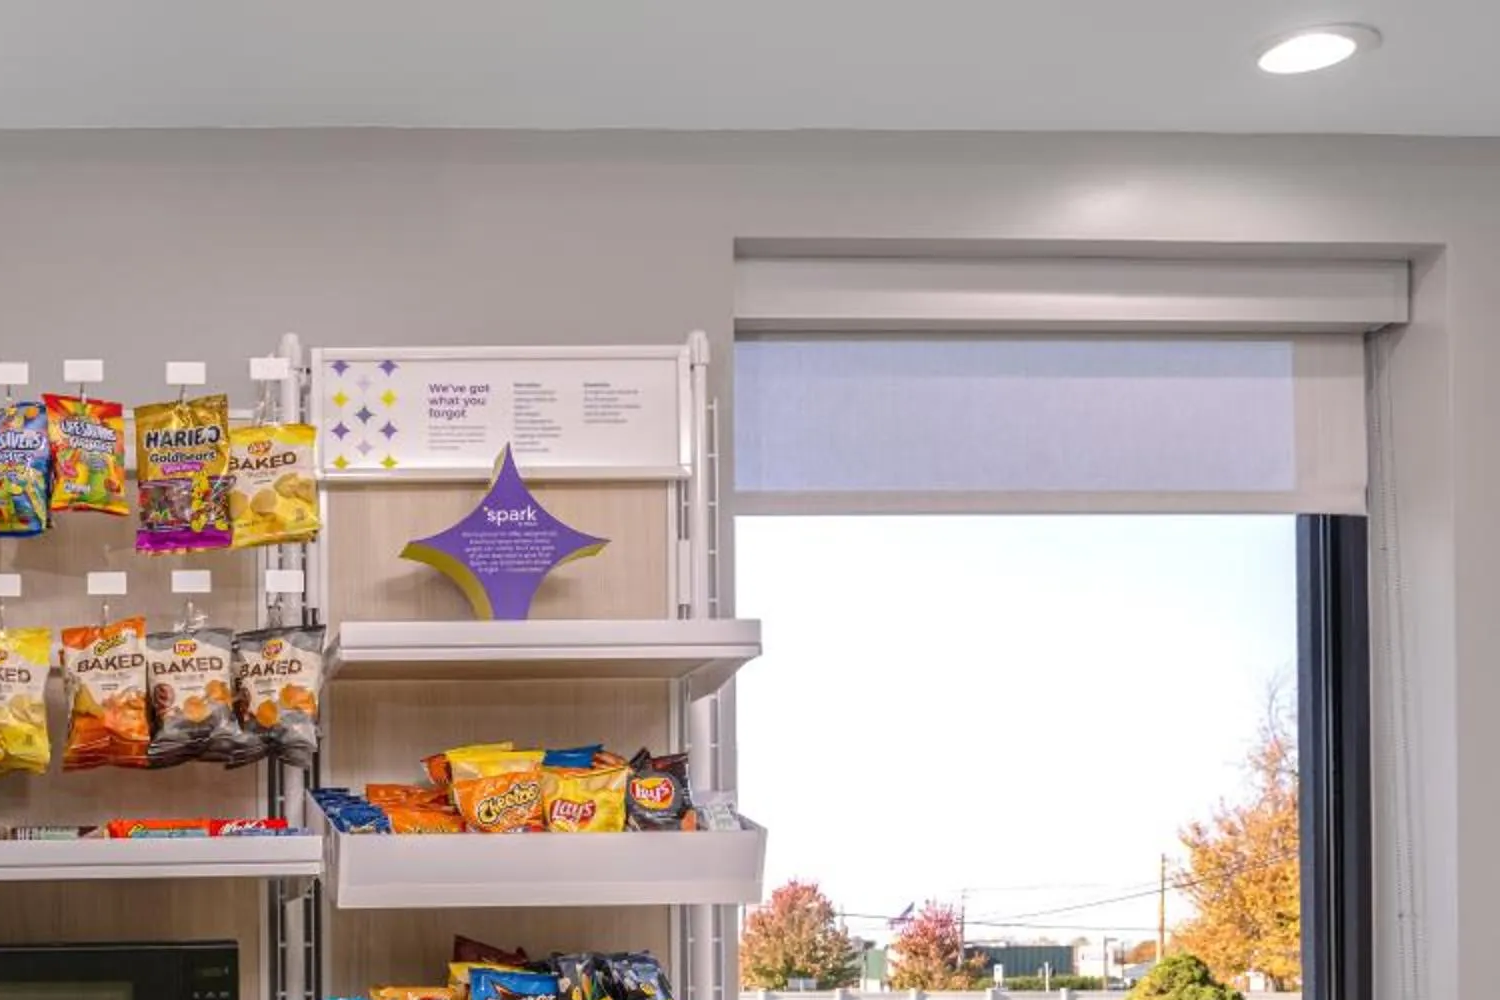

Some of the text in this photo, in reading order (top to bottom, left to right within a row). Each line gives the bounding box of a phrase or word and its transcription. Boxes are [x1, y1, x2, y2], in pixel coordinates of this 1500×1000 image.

[429, 383, 489, 395] We've got
[429, 396, 487, 407] what you
[429, 408, 467, 420] forgot
[228, 452, 297, 471] BAKED
[487, 504, 537, 526] spark
[77, 653, 145, 673] BAKED
[152, 656, 223, 675] BAKED
[240, 659, 303, 678] BAKED
[476, 783, 540, 824] Cheetos
[552, 799, 596, 819] Lay's
